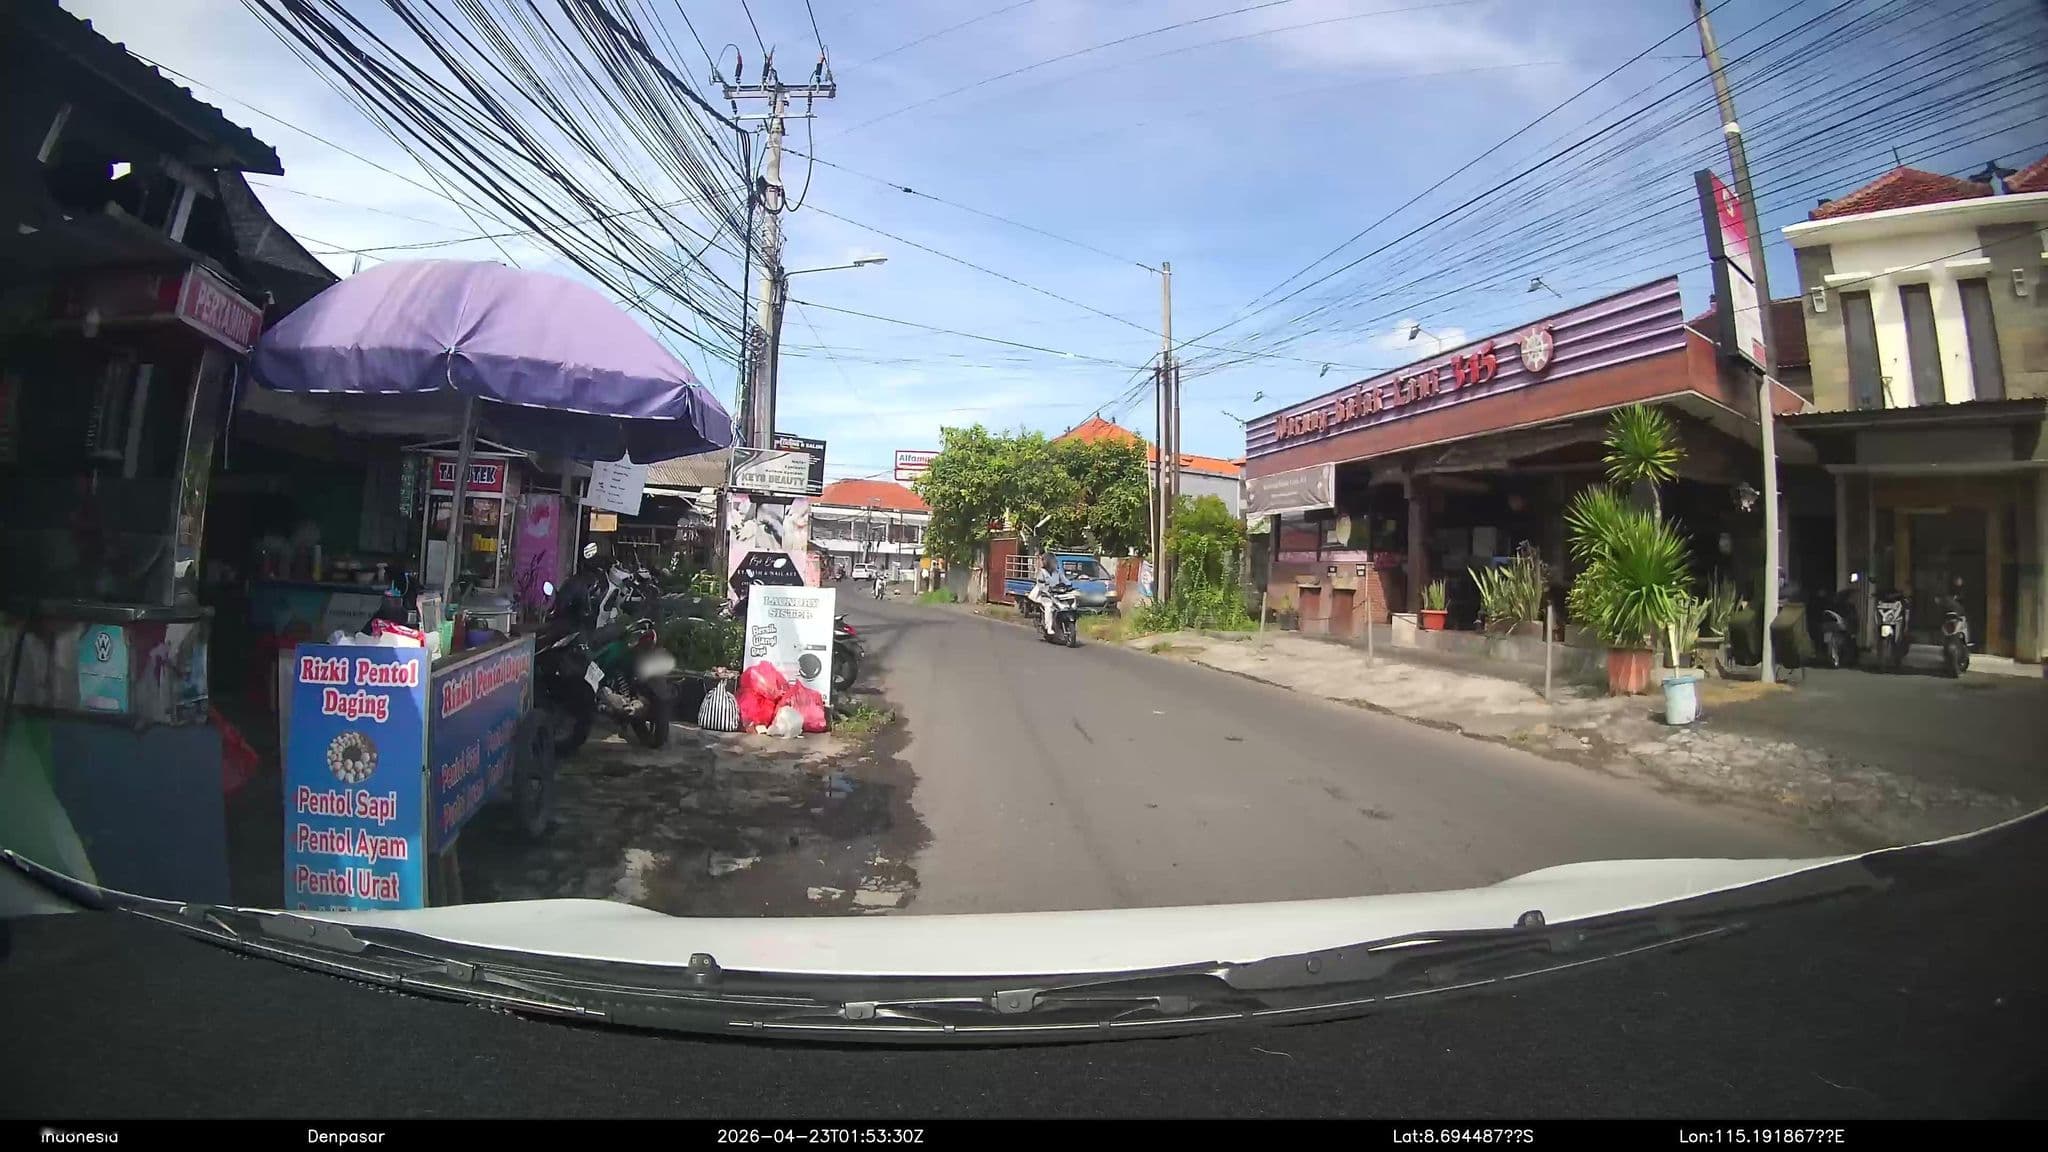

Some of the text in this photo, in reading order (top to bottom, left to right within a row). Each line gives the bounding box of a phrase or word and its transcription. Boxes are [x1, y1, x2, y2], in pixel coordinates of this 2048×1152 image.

[768, 474, 806, 487] BEAUTY
[300, 656, 418, 686] Rizki Pentol
[323, 688, 389, 722] Daging
[442, 673, 473, 719] Rizki
[475, 665, 504, 699] Pentol
[298, 786, 396, 825] Pentol Sapi
[297, 824, 408, 863] Pentol Ayam
[297, 867, 399, 900] Pentol Urat
